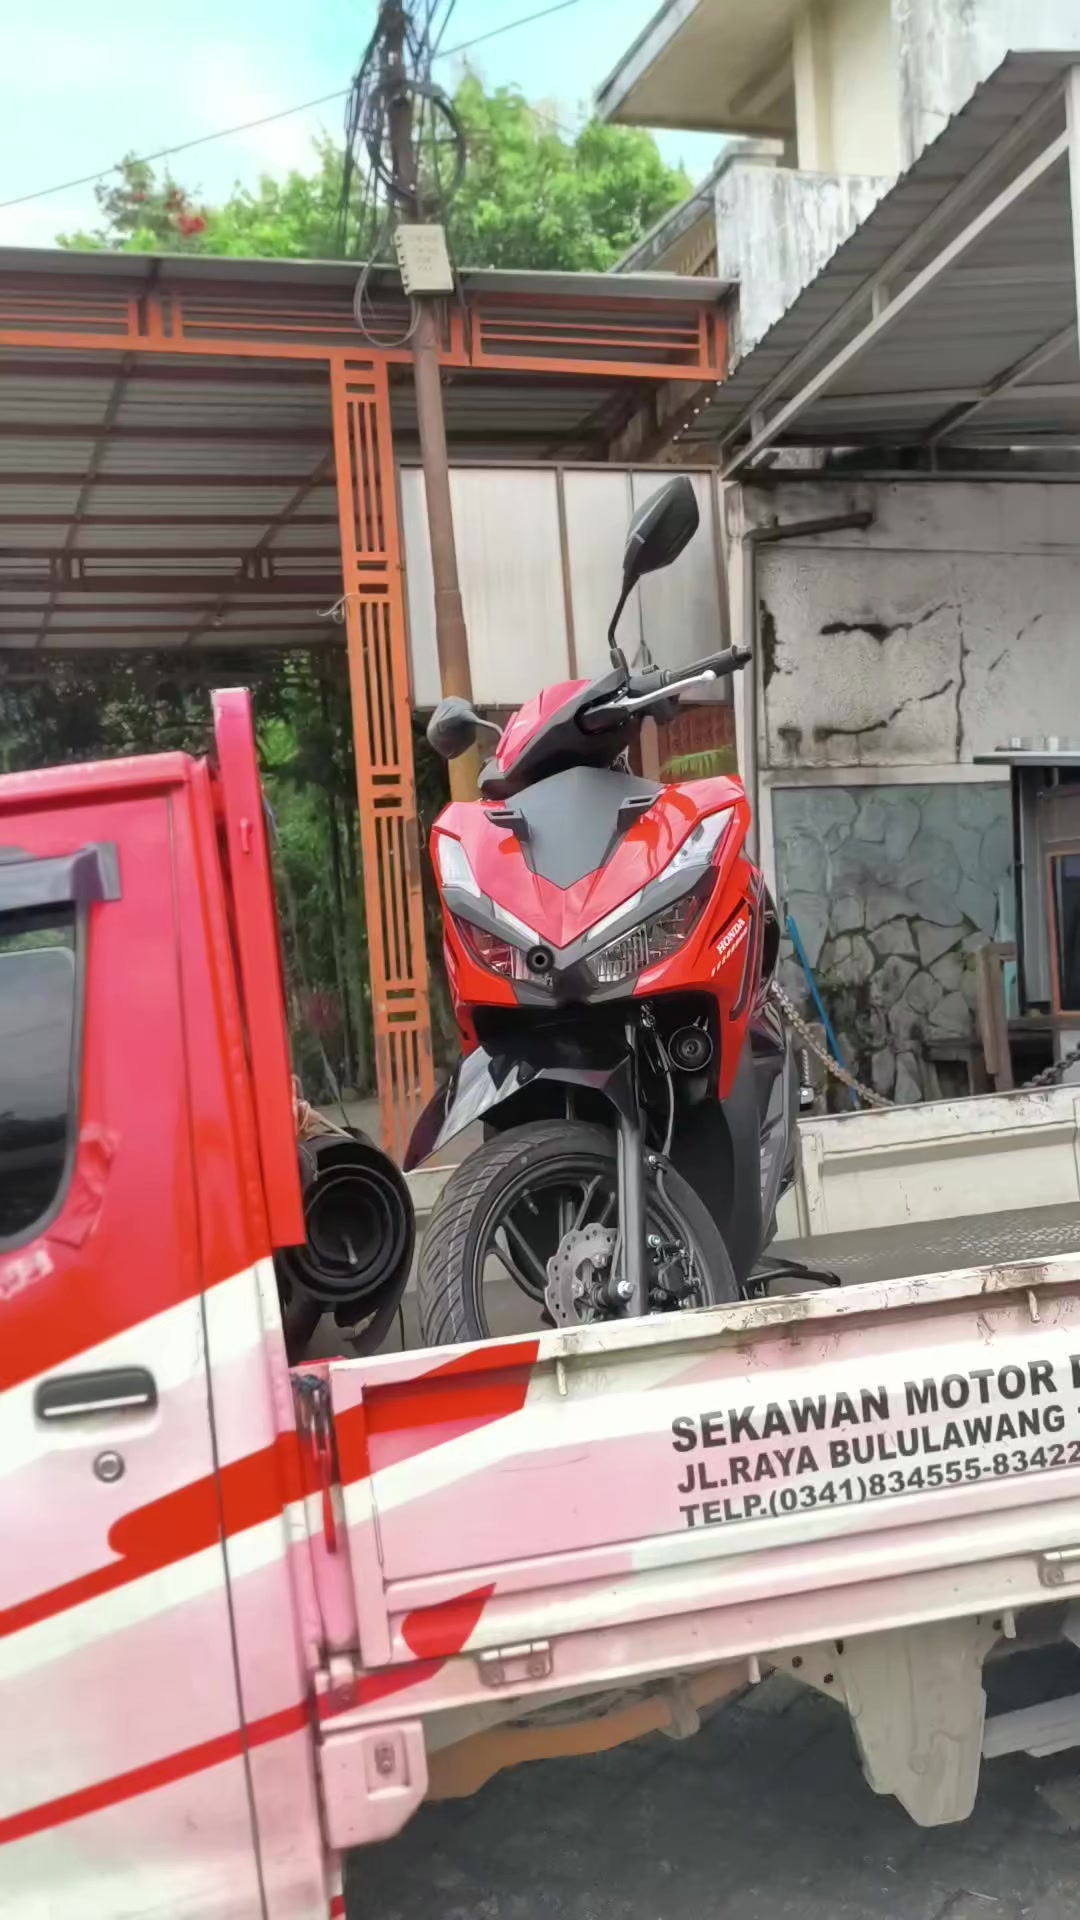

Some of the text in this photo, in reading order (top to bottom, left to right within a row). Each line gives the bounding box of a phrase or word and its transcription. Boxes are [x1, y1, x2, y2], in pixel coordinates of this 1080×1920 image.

[716, 918, 746, 955] HONDA
[671, 1386, 890, 1452] SEKAWAN
[904, 1359, 1058, 1416] MOTOR
[677, 1404, 1065, 1493] JL.RAYA BULULAWANG
